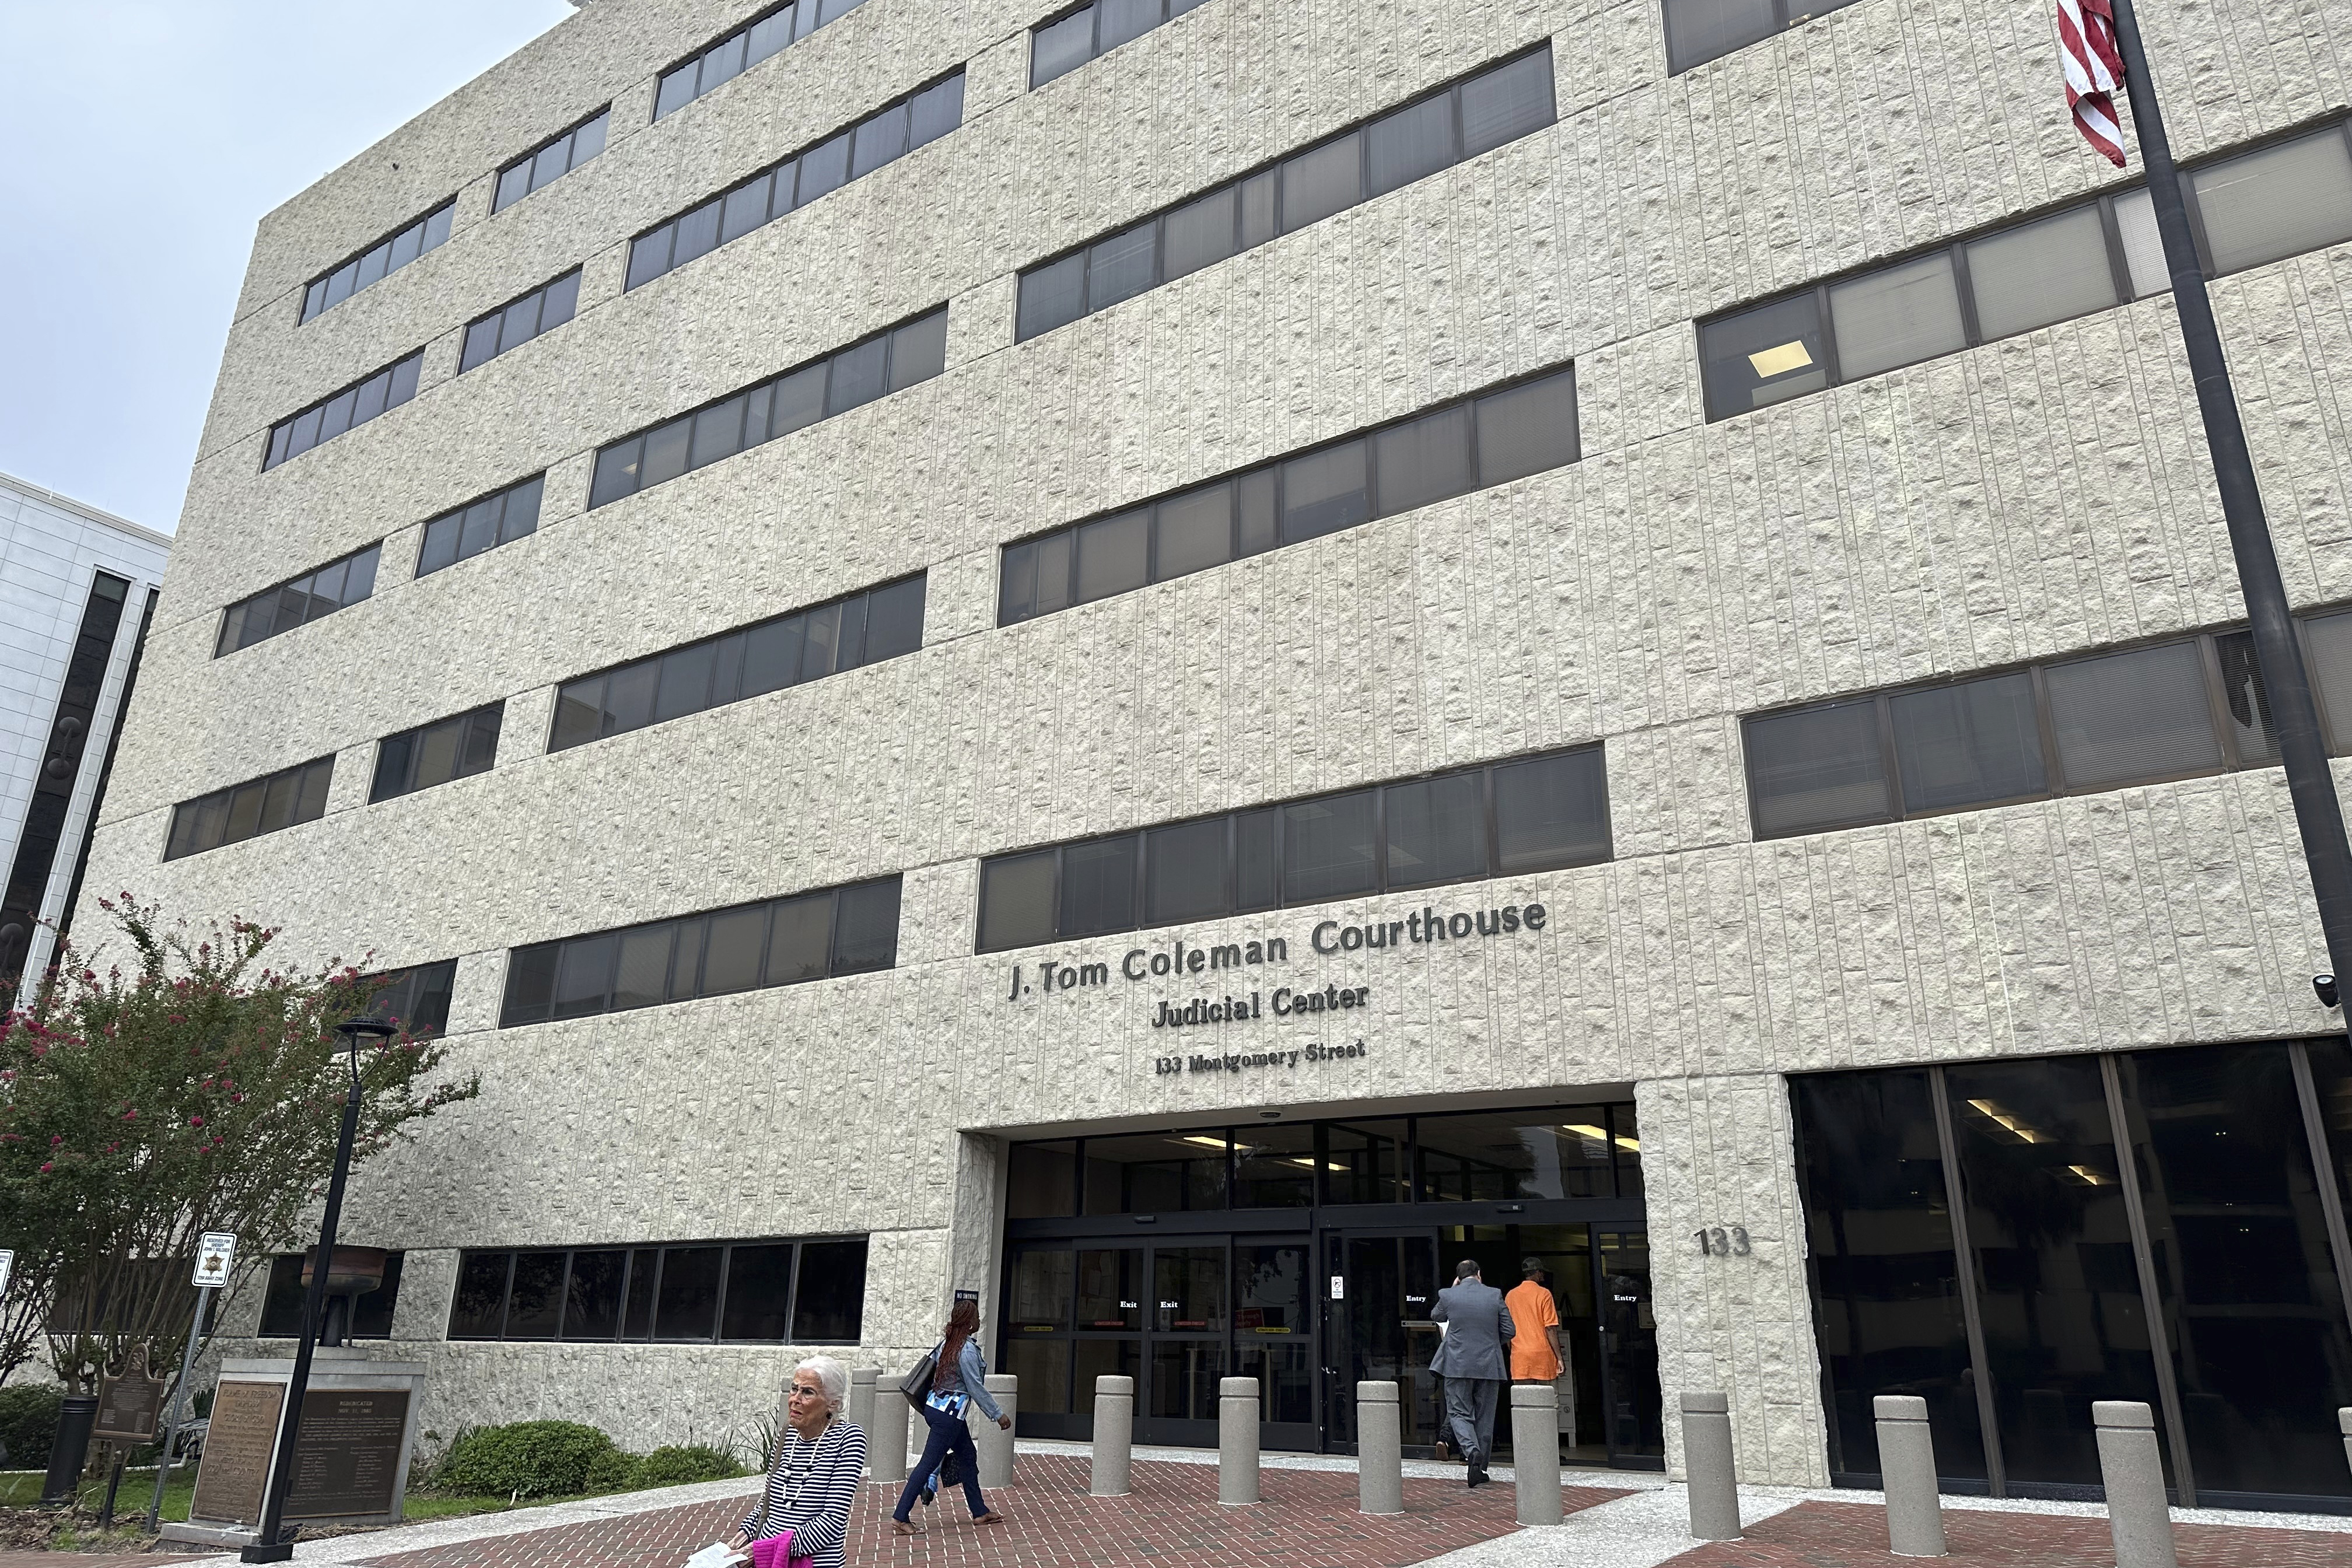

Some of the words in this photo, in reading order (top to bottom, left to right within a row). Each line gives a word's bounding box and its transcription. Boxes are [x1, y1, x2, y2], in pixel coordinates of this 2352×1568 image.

[1008, 965, 1030, 1000] J.
[1039, 961, 1108, 991] Tom
[1122, 936, 1287, 981] Coleman
[1311, 903, 1546, 955] Courthouse
[1152, 991, 1261, 1027] Judicial
[1270, 983, 1370, 1016] Center
[1154, 1056, 1182, 1075] 133
[1188, 1049, 1300, 1072] Montgomery
[1305, 1038, 1366, 1061] Street
[1693, 1226, 1751, 1256] 133
